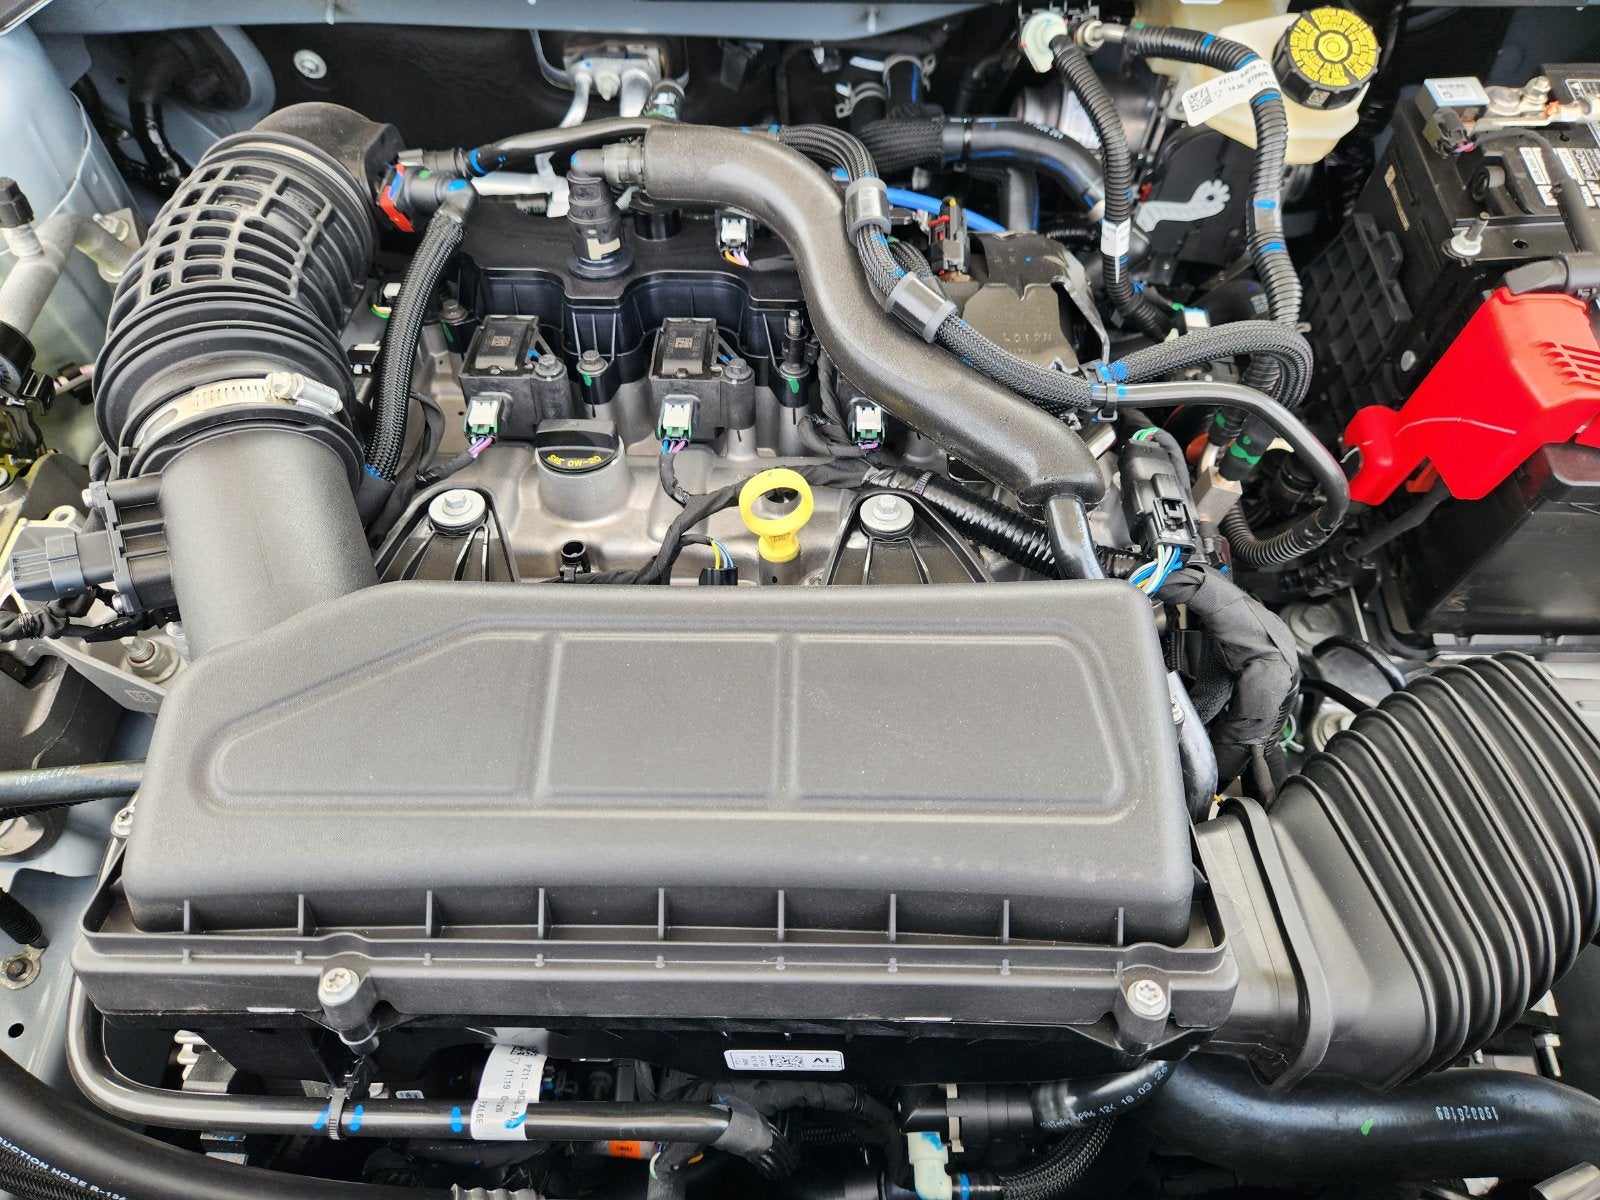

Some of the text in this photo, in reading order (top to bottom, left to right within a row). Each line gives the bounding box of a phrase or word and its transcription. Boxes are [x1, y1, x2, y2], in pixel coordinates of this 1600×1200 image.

[547, 454, 602, 467] SAE 0W-20
[51, 1167, 88, 1188] HOSE
